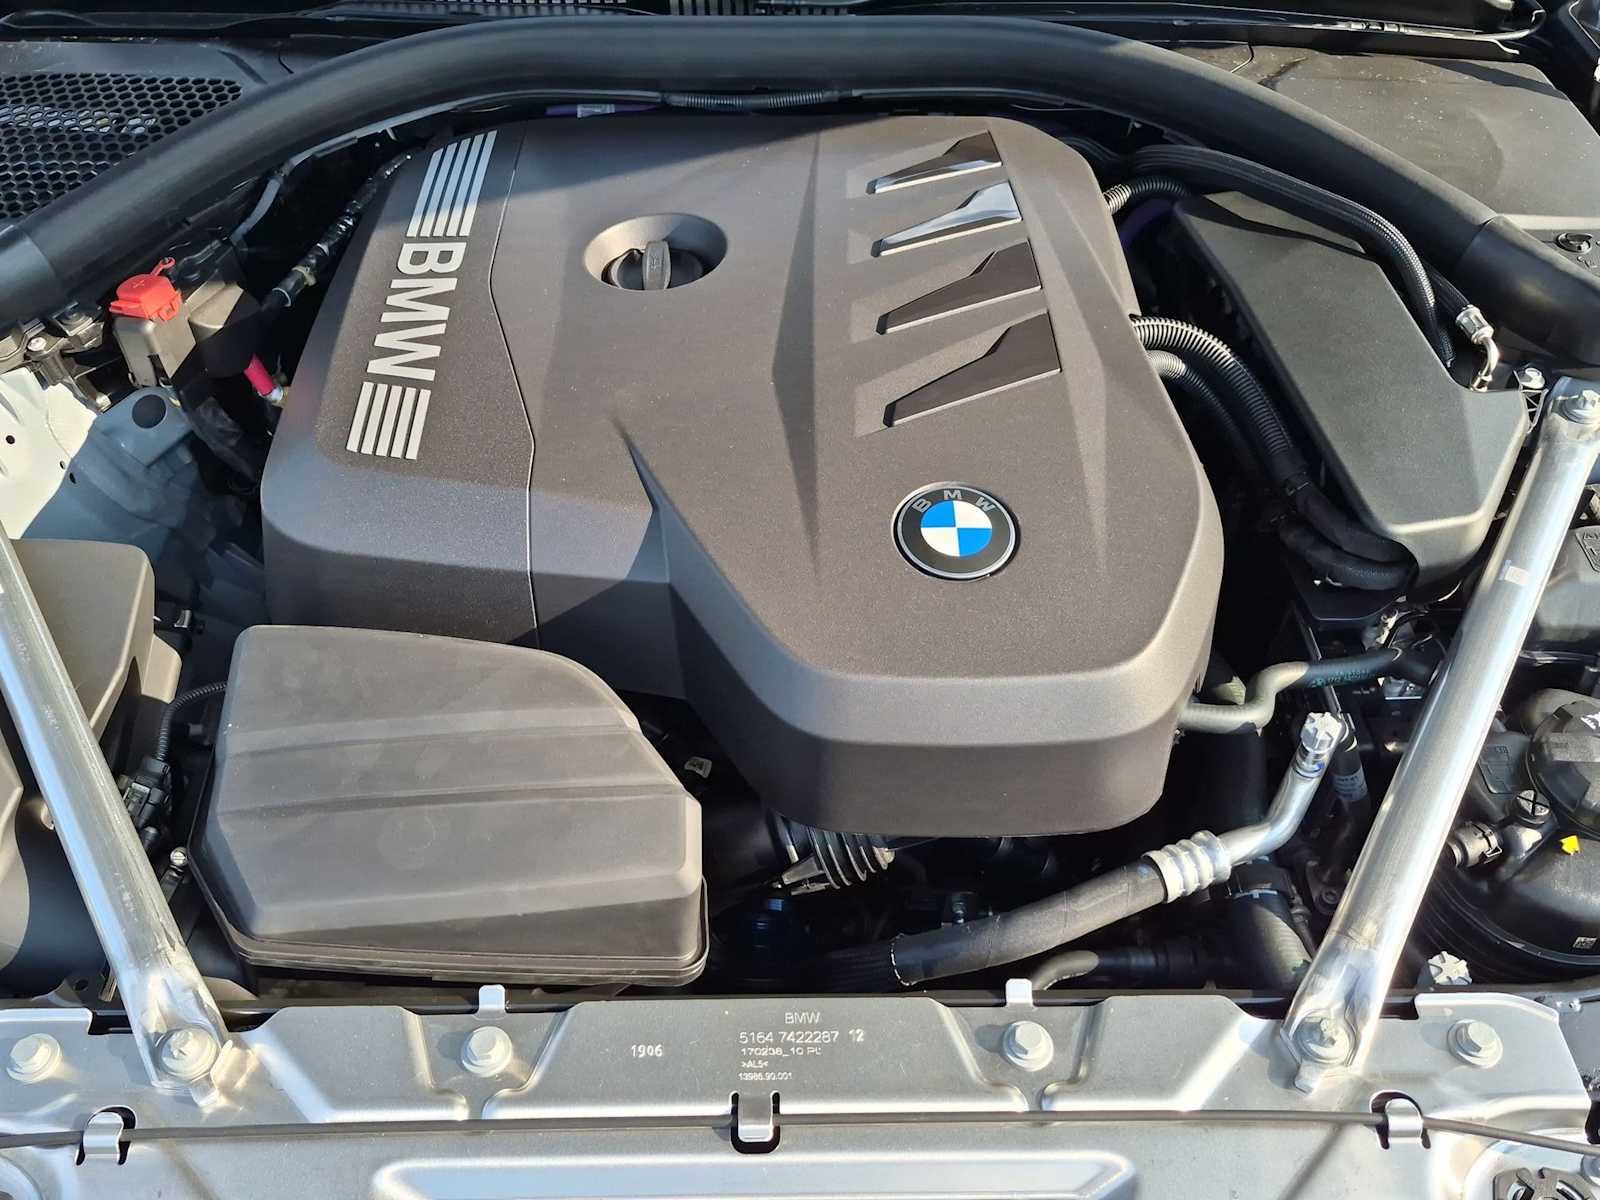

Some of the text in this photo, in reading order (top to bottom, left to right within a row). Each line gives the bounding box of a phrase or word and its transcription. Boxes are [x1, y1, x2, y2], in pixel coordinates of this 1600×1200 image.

[366, 241, 467, 382] BMW
[911, 489, 999, 513] BMW
[784, 1012, 821, 1025] BMW
[739, 1029, 865, 1044] 5164 7422287 12
[631, 1045, 664, 1058] 1906
